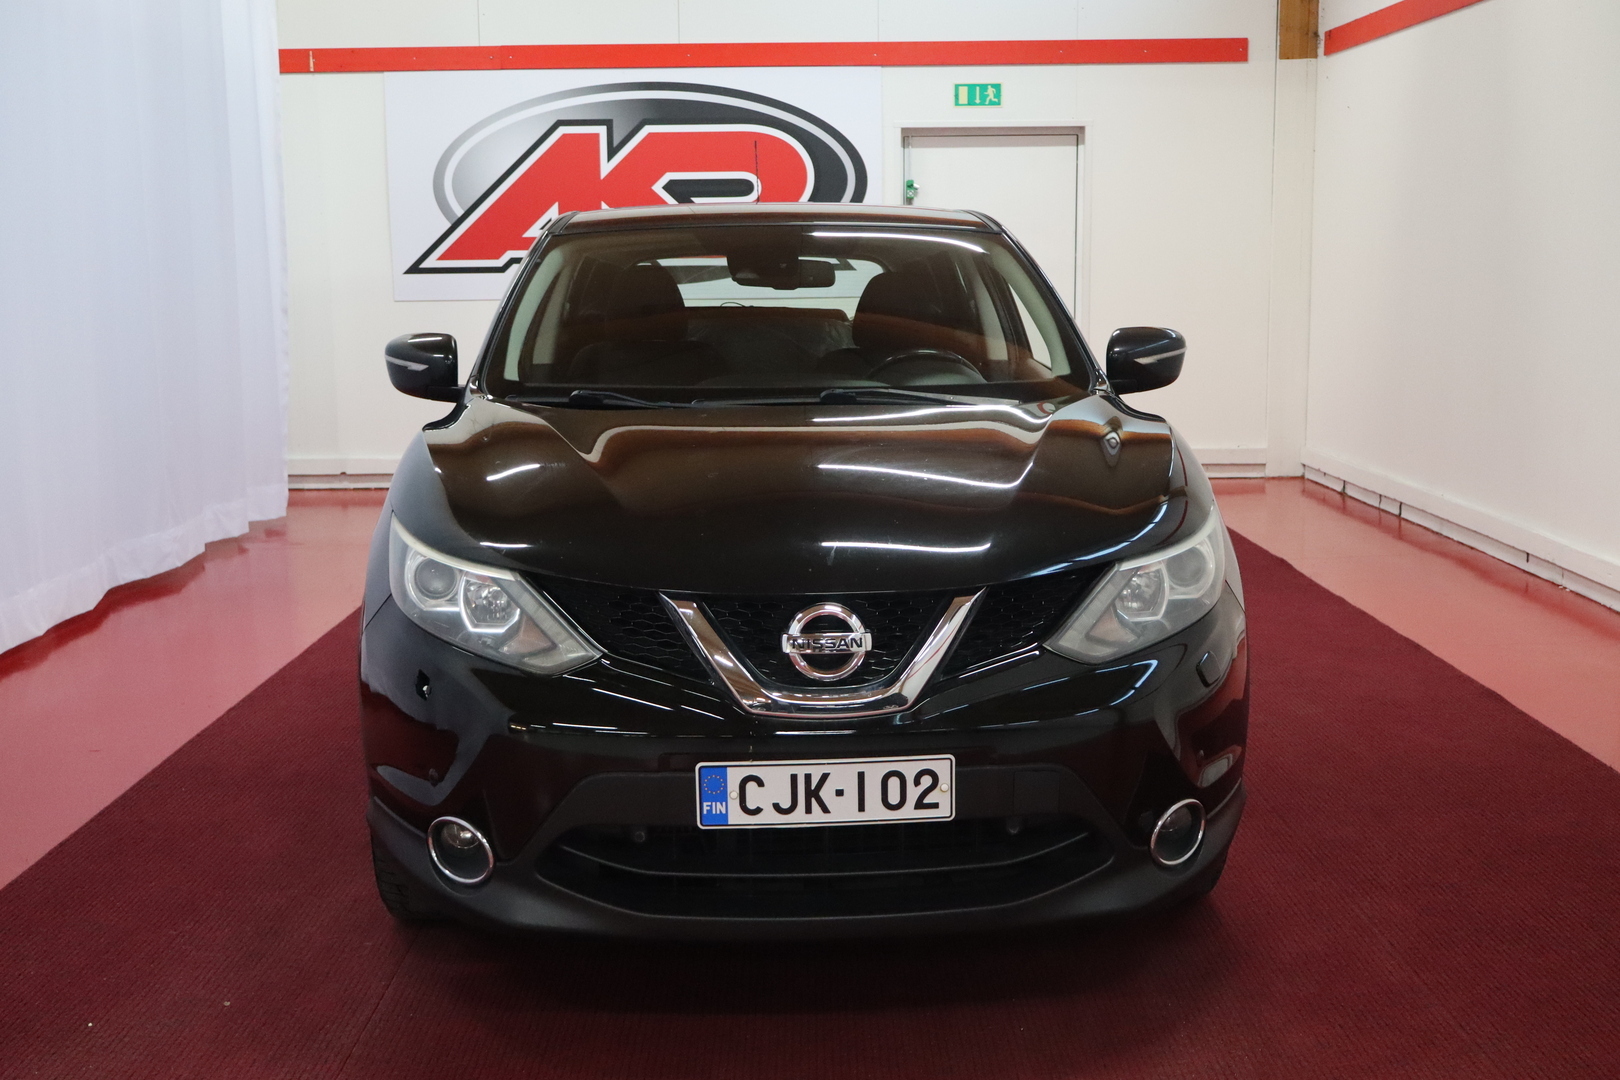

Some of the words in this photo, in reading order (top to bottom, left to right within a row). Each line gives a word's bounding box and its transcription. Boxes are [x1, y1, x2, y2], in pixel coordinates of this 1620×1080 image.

[791, 637, 863, 649] NISSAN
[738, 768, 940, 816] CJK-102
[703, 801, 726, 814] FIN
